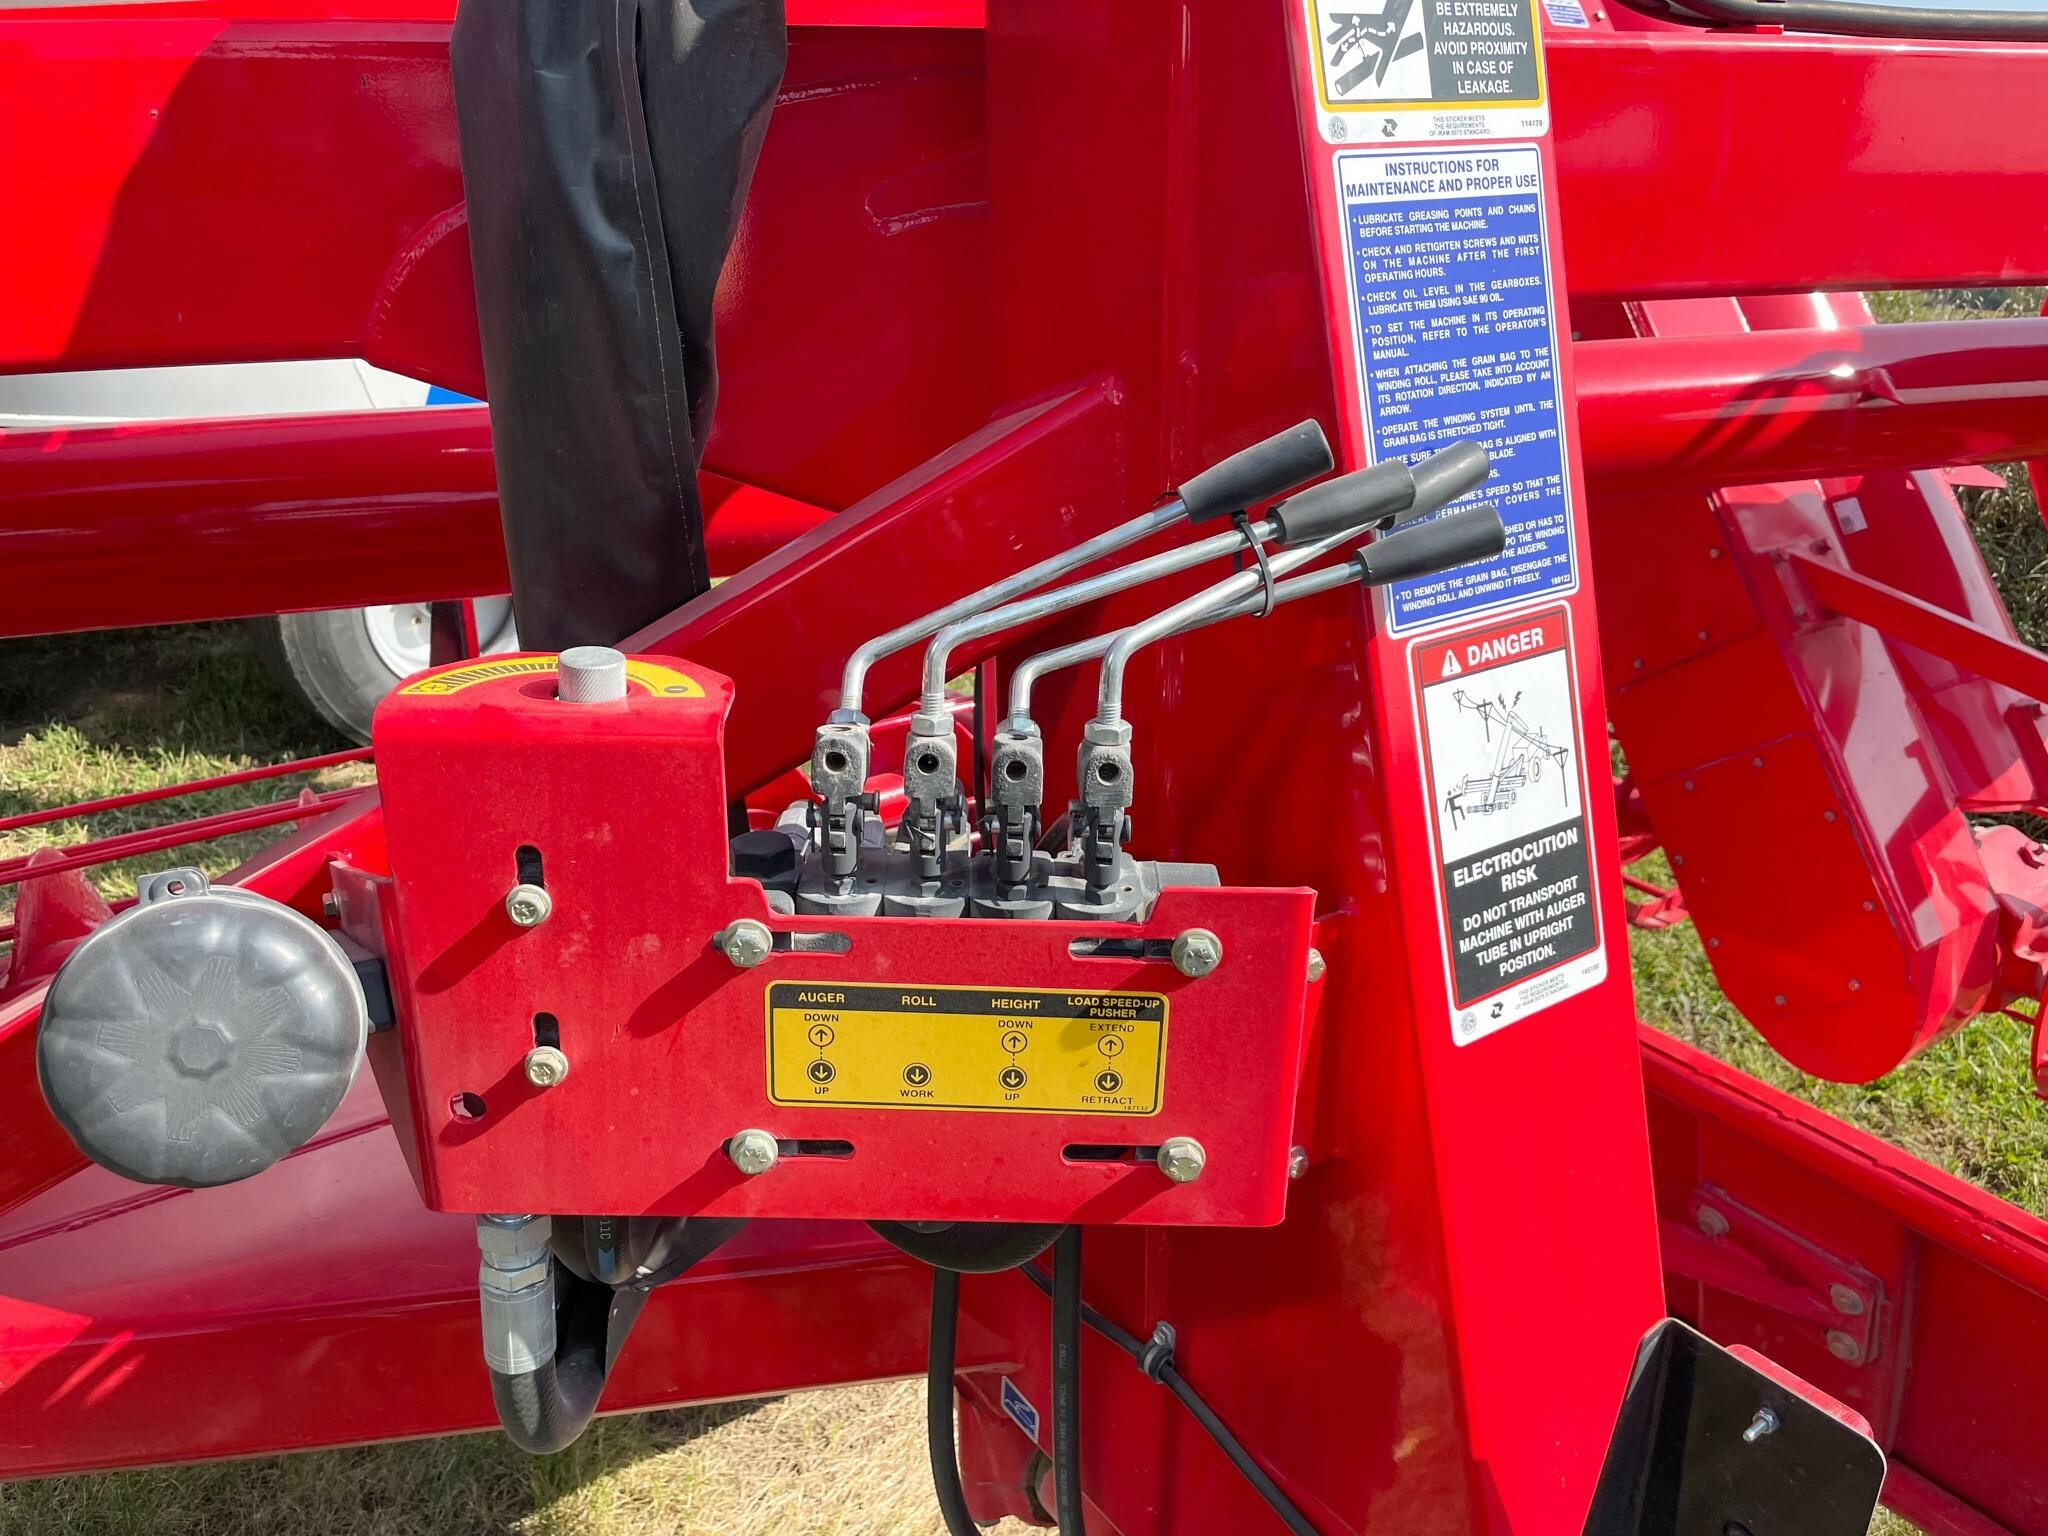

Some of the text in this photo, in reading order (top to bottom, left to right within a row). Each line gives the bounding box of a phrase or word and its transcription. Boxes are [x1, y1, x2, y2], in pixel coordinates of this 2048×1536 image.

[1436, 2, 1517, 16] BE EXTREMELY
[1443, 22, 1515, 35] HAZARDOUS.
[1434, 41, 1527, 55] AVOID PROXIMITY
[1452, 61, 1513, 74] IN CASE OF
[1457, 80, 1513, 93] LEAKAGE.
[1385, 159, 1499, 176] INSTRUCTIONS FOR
[1346, 174, 1537, 197] MAINTENANCE AND PROPER USE
[1358, 204, 1536, 224] LUBRICATE GREASING POINTS AND CHAINS
[1360, 226, 1393, 237] BEFORE
[1394, 223, 1433, 234] STARTING
[1434, 222, 1450, 231] THE
[1361, 234, 1538, 257] CHECK AND RETIGHTEN SCREWS AND NUTS
[1363, 246, 1539, 270] ON THE MACHINE AFTER THE FIRST
[1364, 267, 1446, 283] OPERATING HOURS.
[1366, 276, 1542, 302] CHECK OIL LEVEL IN THE GEARBOXES.
[1368, 302, 1413, 315] LUBRICATE
[1414, 299, 1436, 310] THEM
[1437, 297, 1461, 307] USING
[1462, 295, 1478, 305] SAE
[1479, 294, 1488, 303] 90
[1369, 306, 1545, 334] TO SET THE MACHINE IN ITS OPERATING
[1371, 318, 1546, 347] POSITION, REFER TO THE OPERATOR'S
[1375, 347, 1549, 379] WHEN ATTACHING THE GRAIN BAG TO THE
[1376, 379, 1411, 391] WINDING
[1440, 370, 1470, 382] PLEASE
[1472, 367, 1492, 377] TAKE
[1495, 364, 1512, 374] INTO
[1515, 359, 1549, 372] ACCOUNT
[1378, 371, 1551, 404] ITS ROTATION DIRECTION, INDICATED BY AN
[1380, 404, 1411, 416] ARROW.
[1381, 400, 1554, 435] OPERATE THE WINDING SYSTEM UNTIL THE
[1383, 420, 1506, 447] GRAIN BAG IS STRETCHED TIGHT.
[1505, 429, 1556, 445] ALIGNED WITH
[1488, 448, 1515, 460] BLADE.
[1485, 475, 1560, 497] SPEED SO THAT THE
[1505, 486, 1561, 504] COVERS THE
[1525, 514, 1564, 530] OR HAS TO
[1518, 526, 1565, 543] THE WINDING
[1517, 542, 1547, 555] AUGERS.
[1400, 590, 1412, 599] TO
[1414, 582, 1446, 597] REMOVE
[1448, 578, 1463, 589] THE
[1465, 572, 1488, 585] GRAIN
[1490, 568, 1509, 579] BAG,
[1511, 557, 1552, 574] DISENGAGE
[1553, 554, 1567, 564] THE
[1402, 571, 1541, 612] WINDING ROLL AND UNWIND FREELY.
[1467, 628, 1544, 665] DANGER
[1453, 828, 1578, 887] ELECTROCUTION
[1501, 866, 1538, 891] RISK
[1463, 876, 1578, 932] DO NOT TRANSPORT
[1459, 893, 1585, 953] MACHINE WITH AUGER
[1476, 917, 1573, 965] TUBE IN UPRIGHT
[1499, 943, 1556, 976] POSITION.
[798, 993, 844, 1002] AUGER
[902, 996, 936, 1006] ROLL
[992, 999, 1040, 1009] HEIGHT
[1068, 997, 1160, 1007] LOAD SPEED-UP
[804, 1013, 839, 1022] DOWN
[1090, 1008, 1136, 1018] PUSHER
[998, 1020, 1032, 1028] DOWN
[1090, 1023, 1134, 1032] EXTEND
[1081, 1096, 1133, 1104] RETRACT
